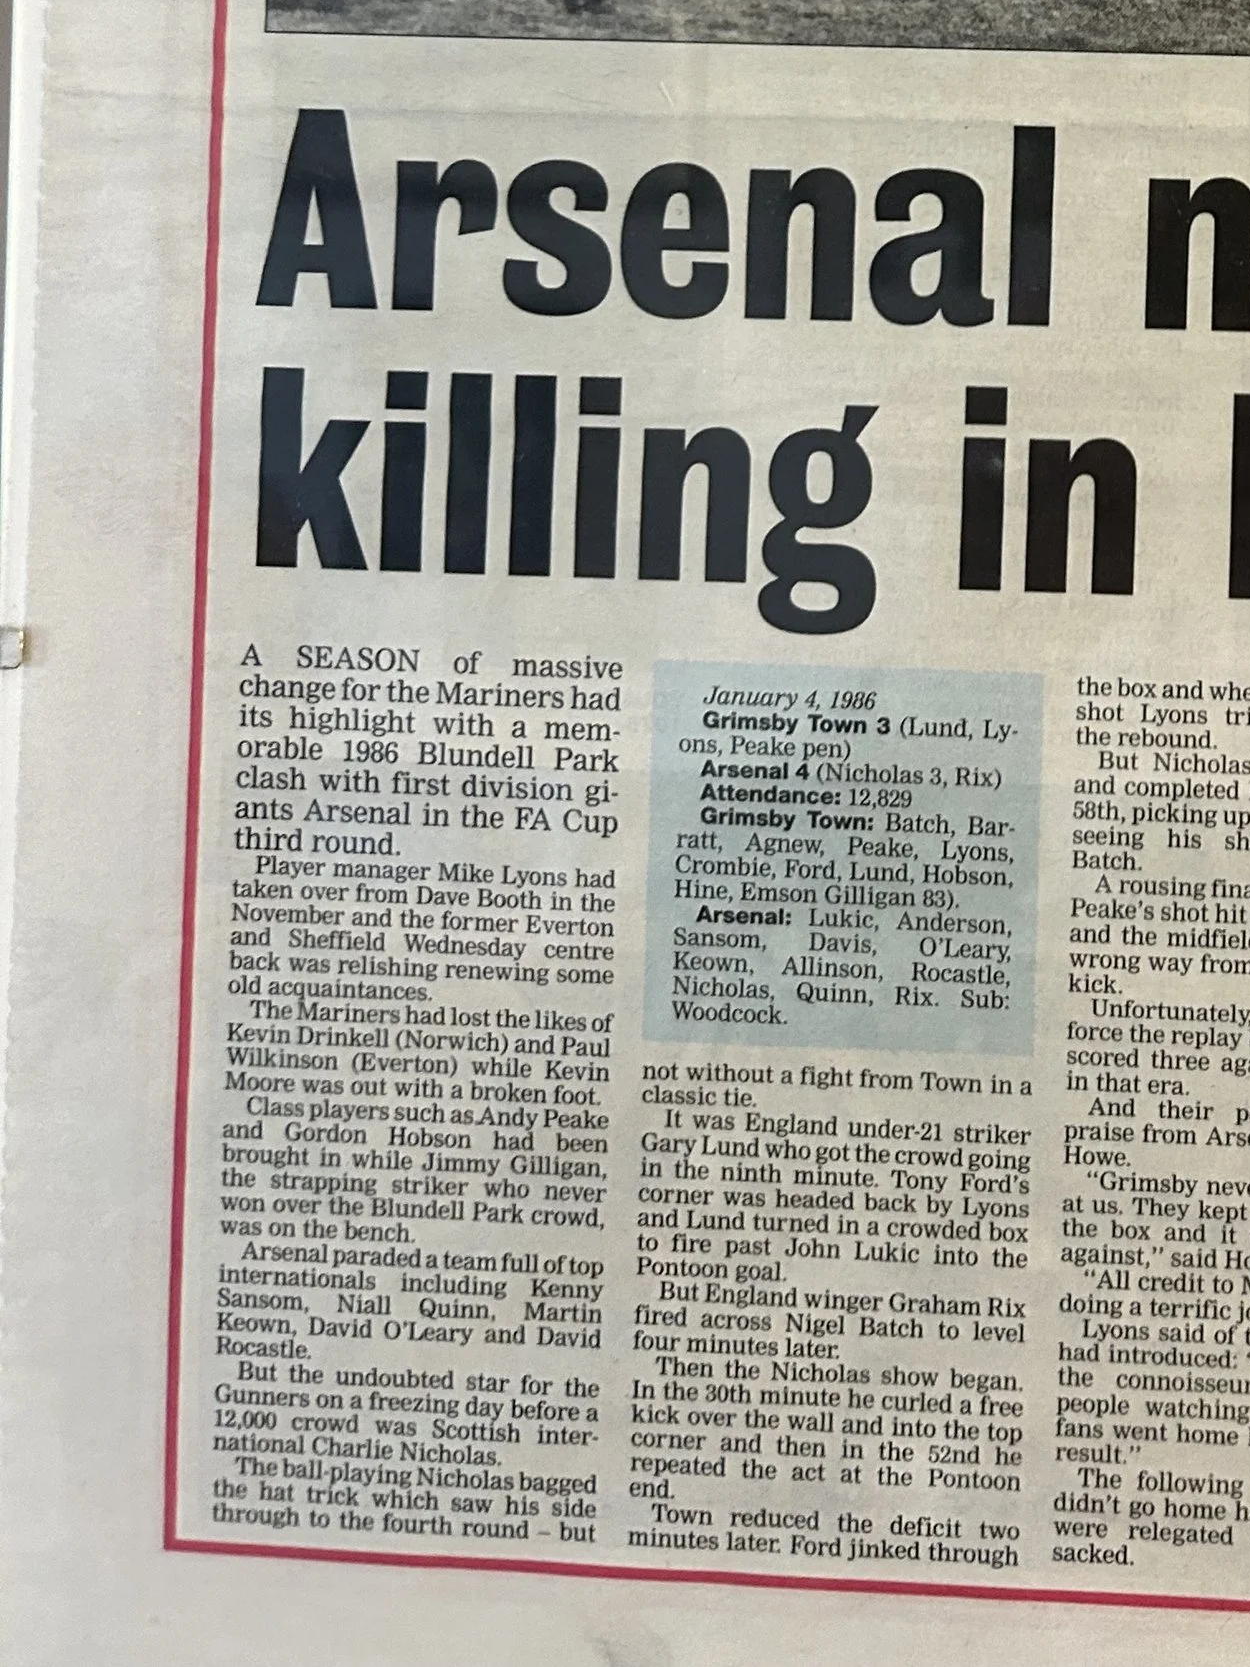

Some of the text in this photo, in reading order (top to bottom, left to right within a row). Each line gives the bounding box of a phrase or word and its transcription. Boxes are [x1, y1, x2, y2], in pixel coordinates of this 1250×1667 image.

[255, 108, 1056, 328] Arsenal
[255, 366, 879, 635] killing
[958, 385, 1137, 596] in
[239, 641, 623, 681] A SEASON of massive
[238, 672, 621, 712] change for the Mariners had
[701, 684, 878, 712] January 4, 1986
[238, 702, 621, 742] its highlight with a mem-
[701, 709, 1018, 744] Grimsby Town 3 (Lund, Ly-
[236, 734, 620, 773] orable 1986 Blundell Park
[677, 733, 851, 763] ons, Peake pen)
[234, 763, 619, 808] clash with first division gi-
[699, 758, 1002, 791] Arsenal 4 (Nicholas 3, Rix)
[698, 782, 913, 811] Attendance: 12,829
[233, 797, 618, 839] ants Arsenal in the FA Cup
[699, 804, 1015, 838] Grimsby Town: Batch, Bar-
[232, 824, 401, 857] third round.
[672, 998, 788, 1025] Woodcock.
[654, 1354, 1023, 1395] Then the Nicholas show began.
[213, 1407, 599, 1446] 12,000 crowd was Scottish inter-
[650, 1501, 1020, 1541] Town reduced the deficit two
[1052, 1520, 1108, 1539] were
[1127, 1520, 1234, 1547] relegated
[1051, 1541, 1134, 1566] sacked.
